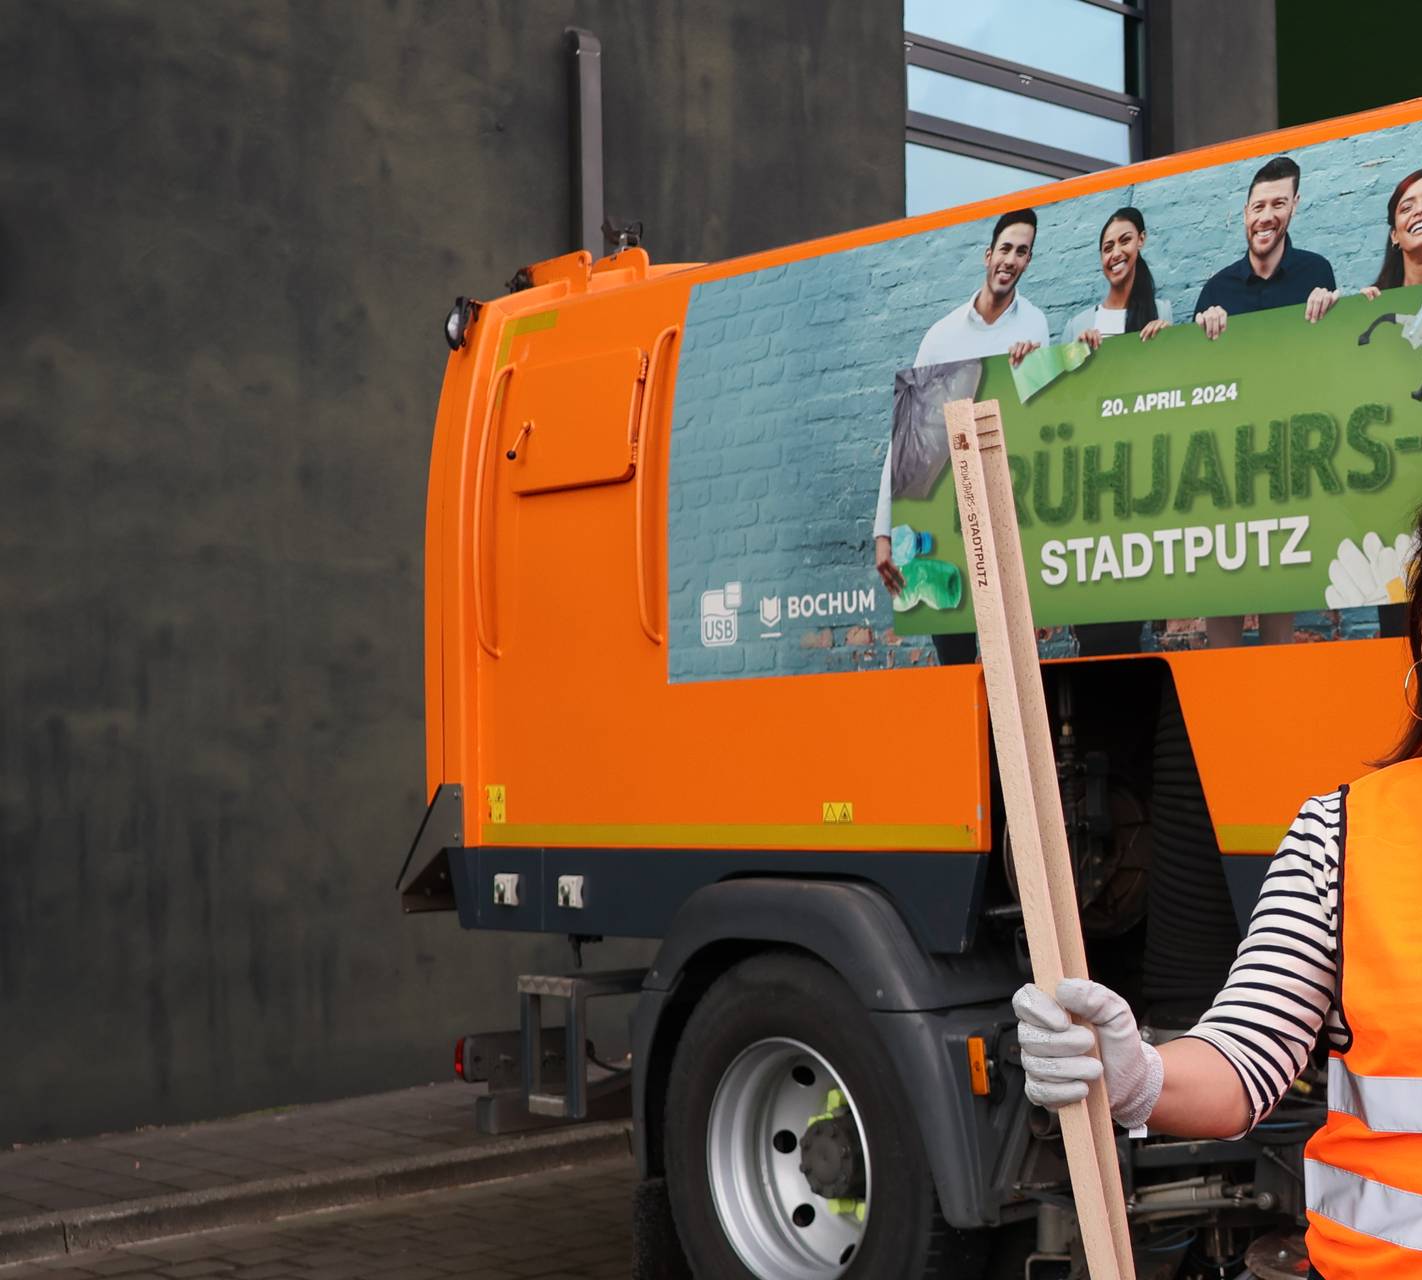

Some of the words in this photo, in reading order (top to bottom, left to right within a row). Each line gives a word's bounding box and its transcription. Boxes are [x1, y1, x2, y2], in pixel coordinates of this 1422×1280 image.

[1101, 398, 1129, 417] 20.
[1133, 389, 1186, 413] APRIL
[1191, 382, 1238, 405] 2024
[1040, 515, 1312, 586] STADTPUTZ
[787, 587, 876, 619] BOCHUM
[704, 616, 734, 641] USB
